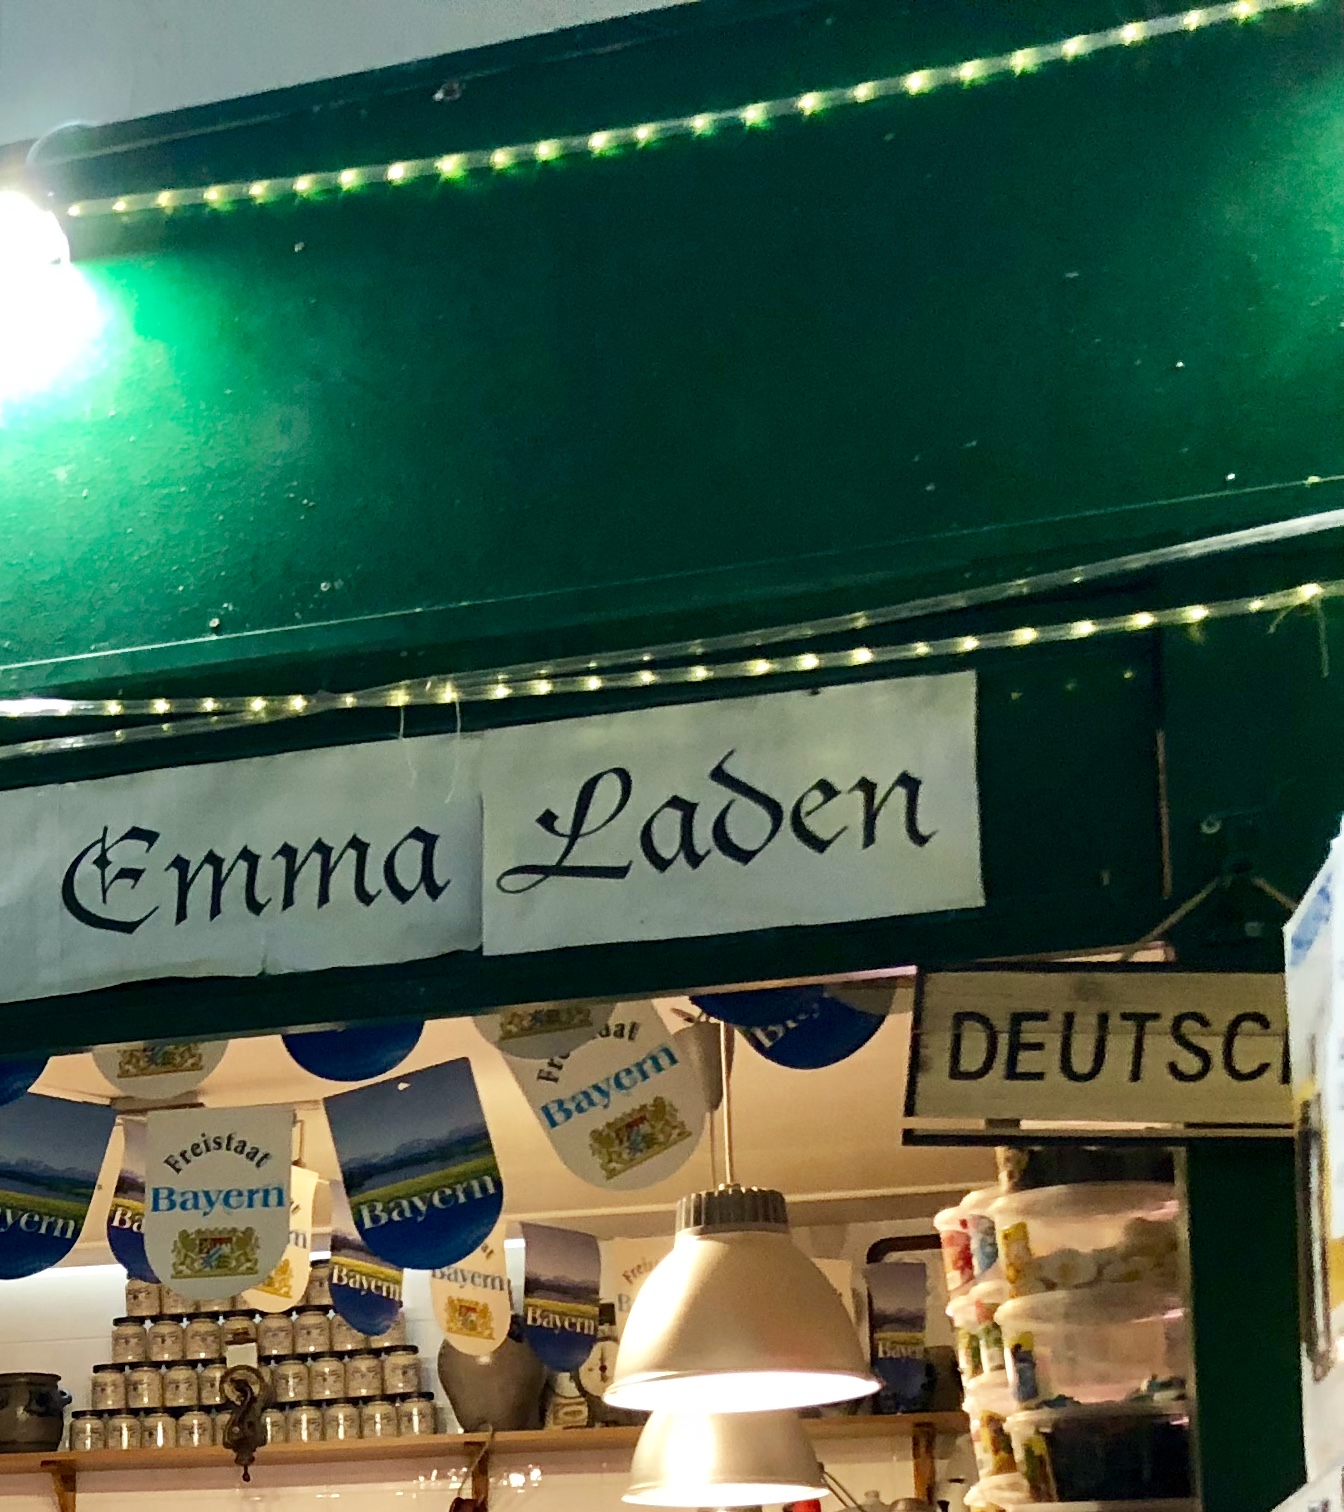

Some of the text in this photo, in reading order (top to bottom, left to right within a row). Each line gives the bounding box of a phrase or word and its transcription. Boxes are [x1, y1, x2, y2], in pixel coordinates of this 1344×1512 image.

[60, 824, 452, 934] Emma
[496, 749, 938, 894] Laden
[540, 1043, 680, 1130] Bayern
[163, 1132, 273, 1175] Freistaat
[150, 1184, 286, 1217] Bayern
[359, 1172, 497, 1231] Bayern
[331, 1263, 403, 1301] Bayern
[526, 1304, 599, 1337] Bayern
